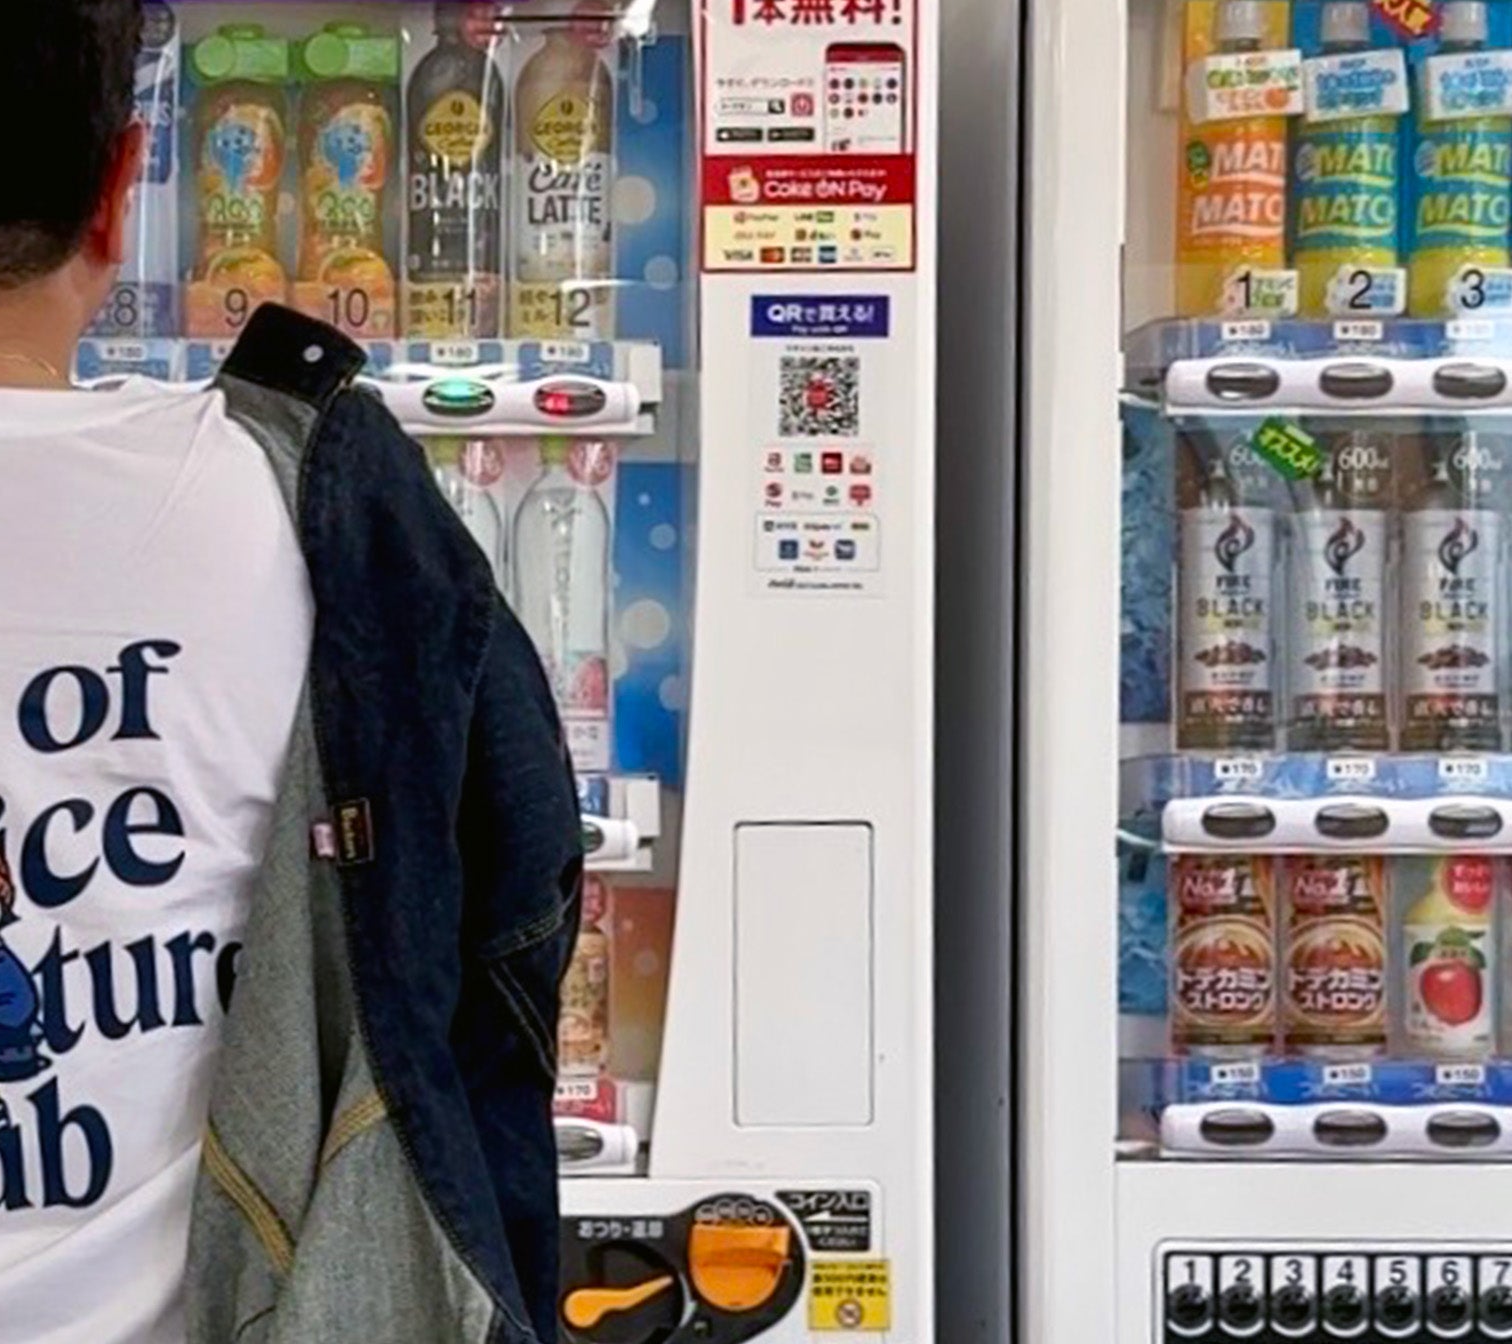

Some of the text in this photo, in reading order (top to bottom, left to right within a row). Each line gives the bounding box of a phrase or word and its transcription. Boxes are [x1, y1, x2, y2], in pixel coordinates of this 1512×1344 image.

[410, 171, 500, 211] BLACK
[764, 181, 813, 198] Coke
[849, 180, 887, 201] Pay
[527, 195, 602, 225] LATTE
[1236, 269, 1251, 309] 1
[1348, 269, 1374, 309] 2
[1460, 269, 1486, 310] 3
[113, 288, 137, 327] 8
[224, 287, 248, 328] 9
[328, 289, 369, 326] 10
[442, 287, 477, 326] 11
[549, 287, 592, 327] 12
[1216, 575, 1251, 589] FIRE
[1195, 599, 1264, 618] BLACK
[1305, 601, 1373, 621] BLACK
[1418, 601, 1487, 620] BLACK
[16, 638, 183, 754] of
[790, 1193, 869, 1210] コイン入口
[1184, 1259, 1196, 1283] 1
[1234, 1259, 1251, 1283] 2
[1286, 1259, 1303, 1285] 3
[1336, 1259, 1354, 1283] 4
[1388, 1260, 1407, 1285] 5
[1440, 1260, 1459, 1285] 6
[1492, 1260, 1512, 1284] 7
